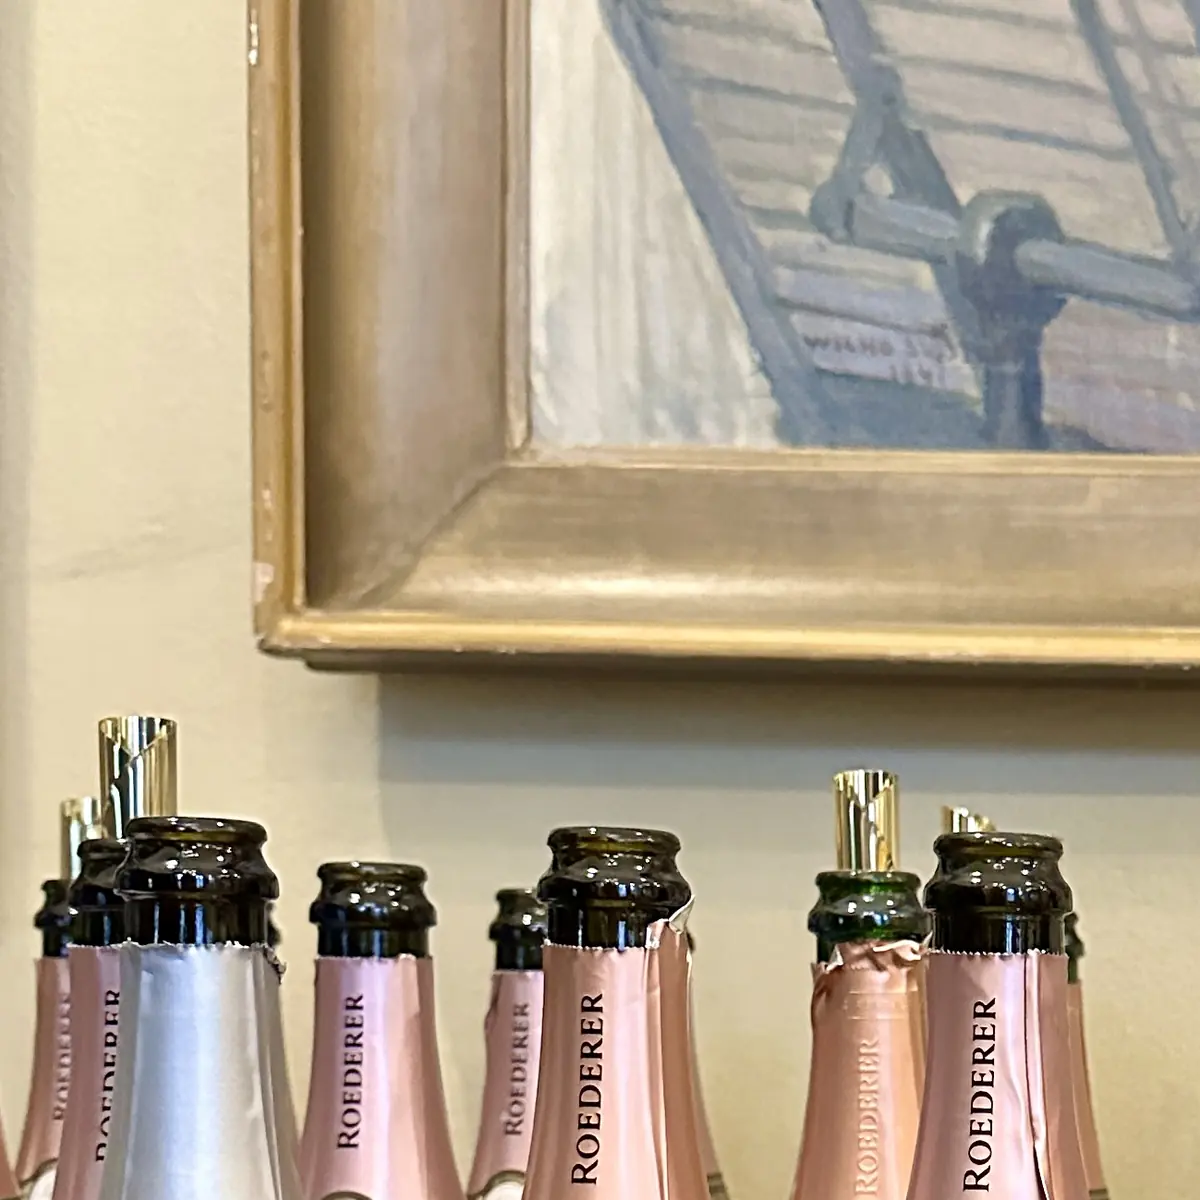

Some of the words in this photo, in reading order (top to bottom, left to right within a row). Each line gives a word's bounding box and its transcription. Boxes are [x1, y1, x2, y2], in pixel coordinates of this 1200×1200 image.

[337, 993, 364, 1150] ROEDERER
[505, 1001, 530, 1137] ROEDERER
[571, 993, 604, 1186] ROEDERER
[855, 1038, 880, 1196] ROEDERER
[962, 997, 996, 1193] ROEDERER
